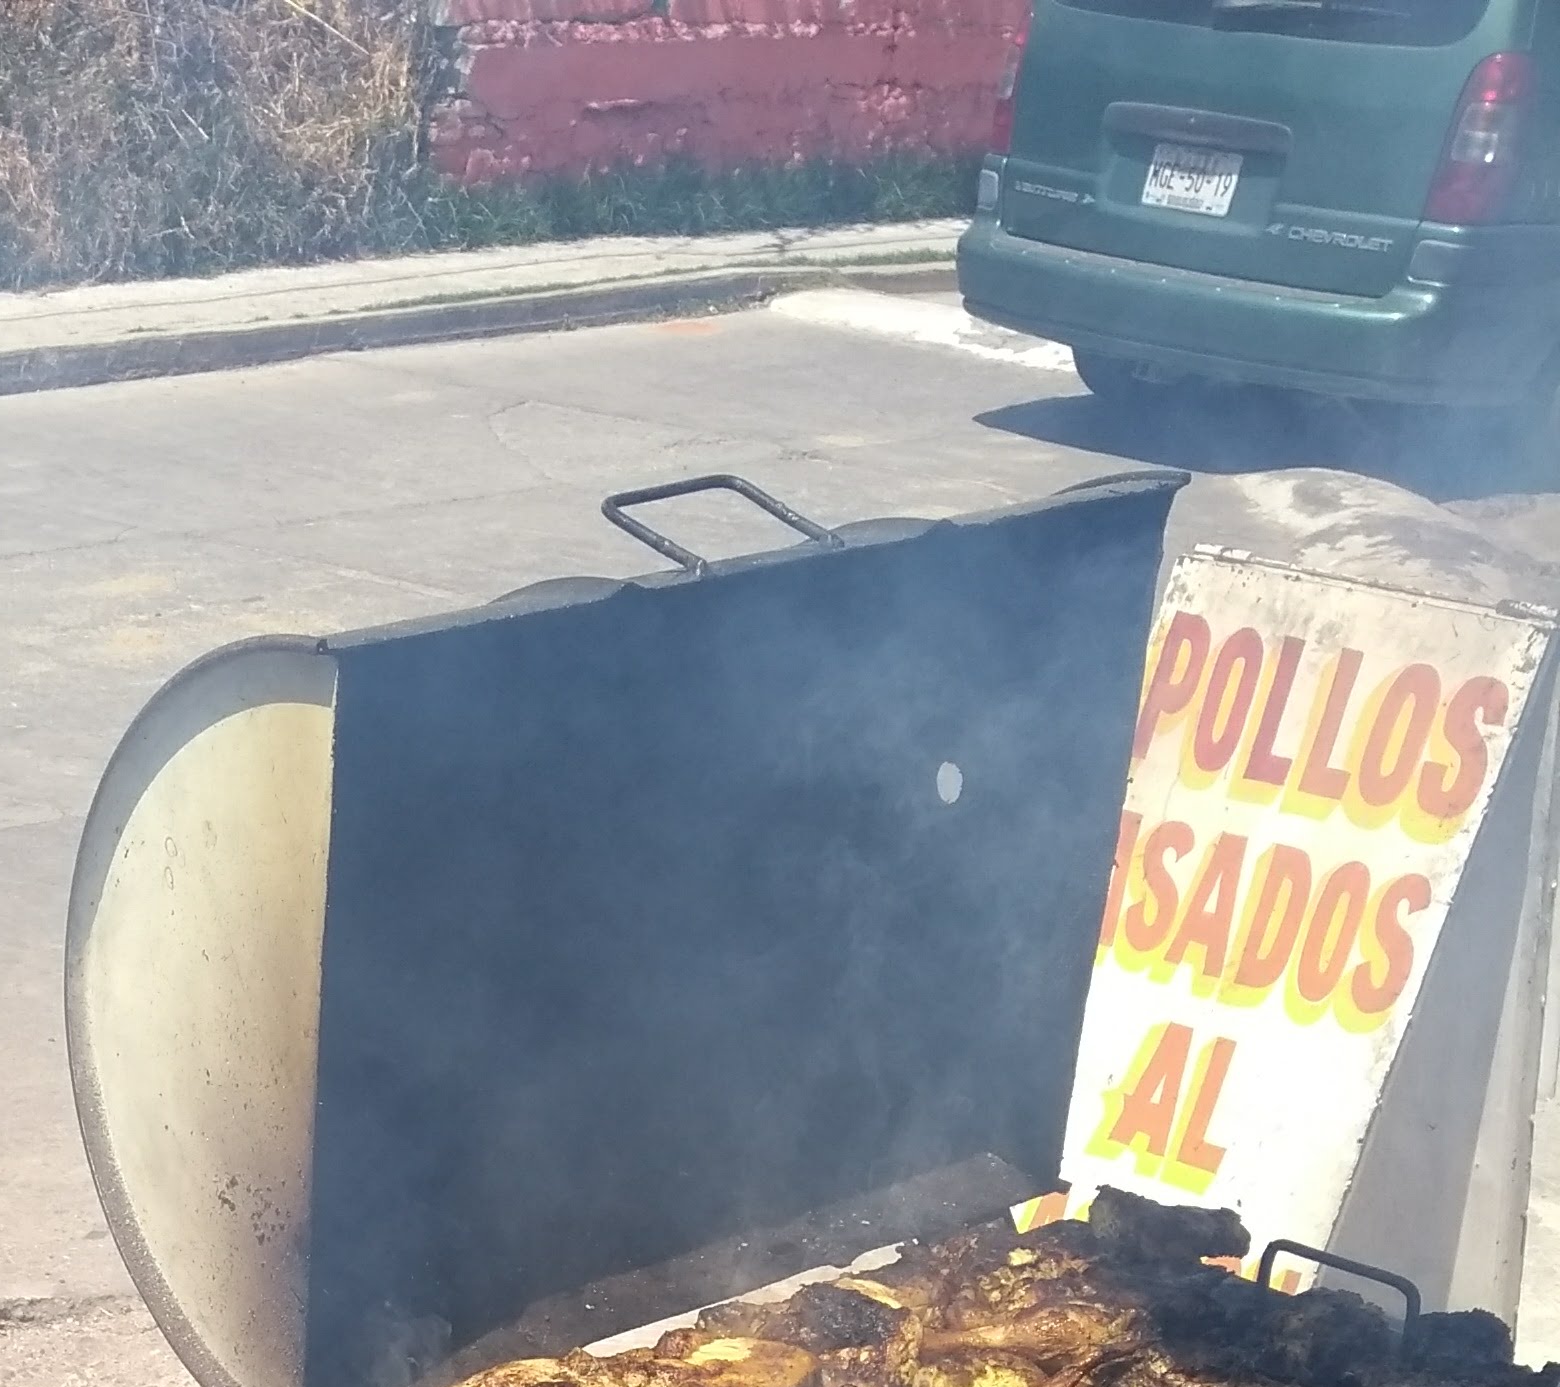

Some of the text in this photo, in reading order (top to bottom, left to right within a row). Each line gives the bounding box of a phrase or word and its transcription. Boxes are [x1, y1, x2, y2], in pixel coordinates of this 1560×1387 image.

[1288, 226, 1393, 252] CHEVROLET
[1134, 610, 1510, 822] POLLOS
[1106, 1020, 1238, 1176] AL
